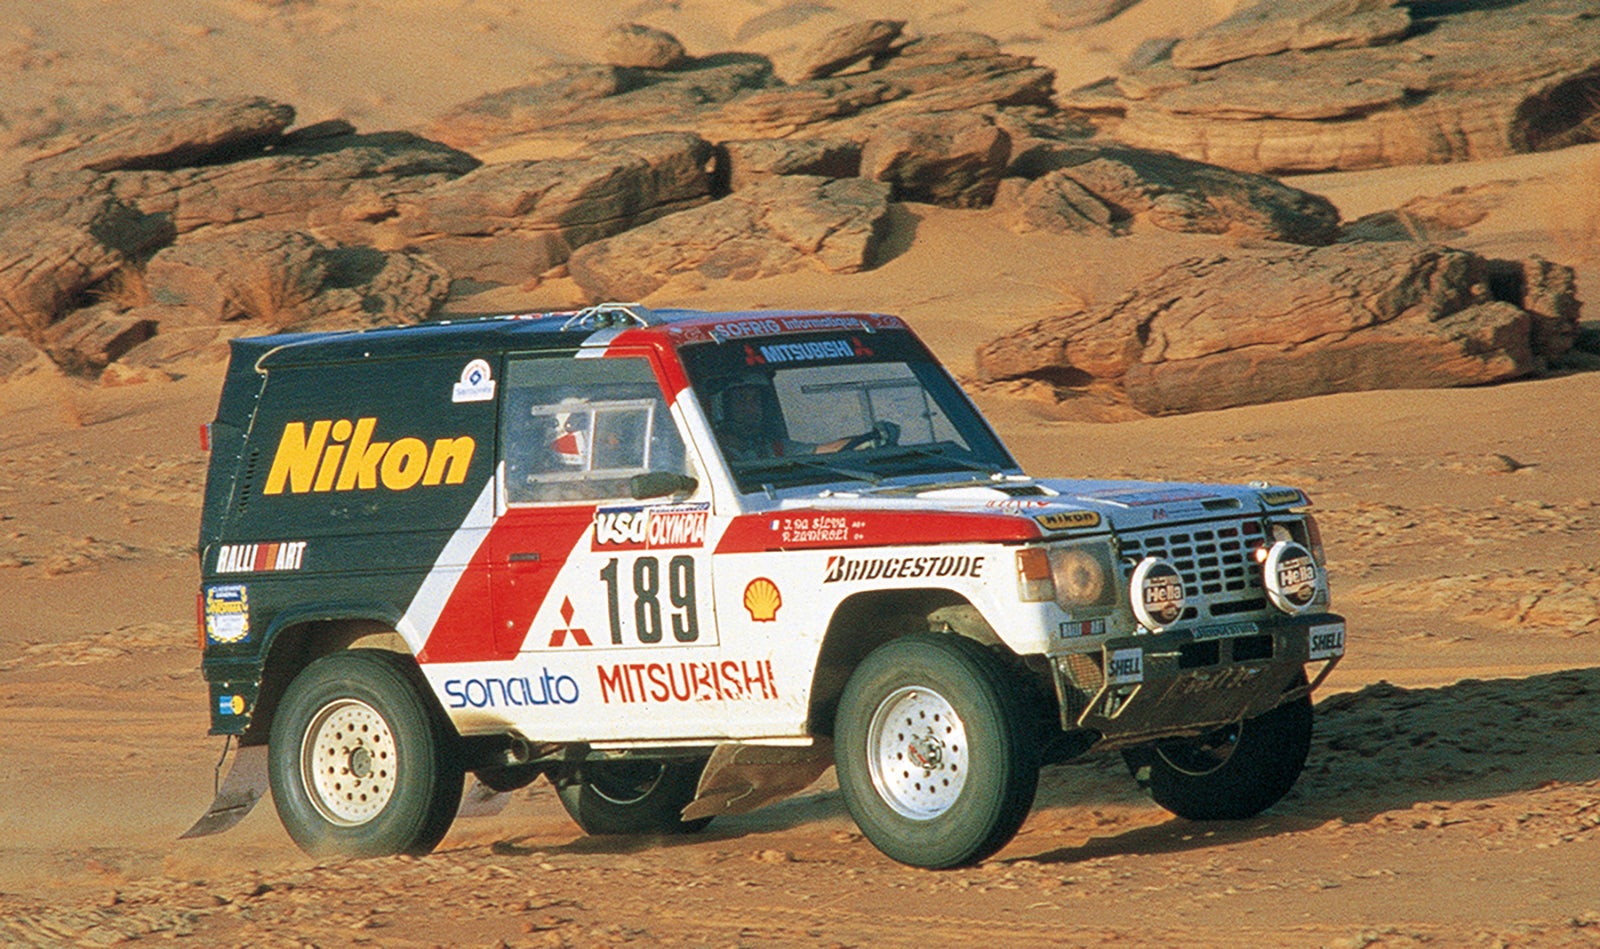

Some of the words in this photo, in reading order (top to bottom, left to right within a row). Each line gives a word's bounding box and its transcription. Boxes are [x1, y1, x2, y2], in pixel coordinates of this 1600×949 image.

[759, 339, 854, 363] MITSUBISHI
[263, 417, 476, 495] Nikon
[648, 513, 706, 546] OLYMPIA
[216, 544, 258, 574] RALLI
[275, 541, 307, 571] ART
[823, 555, 986, 584] BRIDGESTONE
[1280, 565, 1314, 587] Hella
[599, 555, 699, 645] 189
[1145, 585, 1182, 603] Hella
[1311, 631, 1343, 652] SHELL
[597, 659, 779, 704] MITSUBISHI
[1108, 657, 1141, 678] SHELL
[444, 667, 580, 708] sonauto
